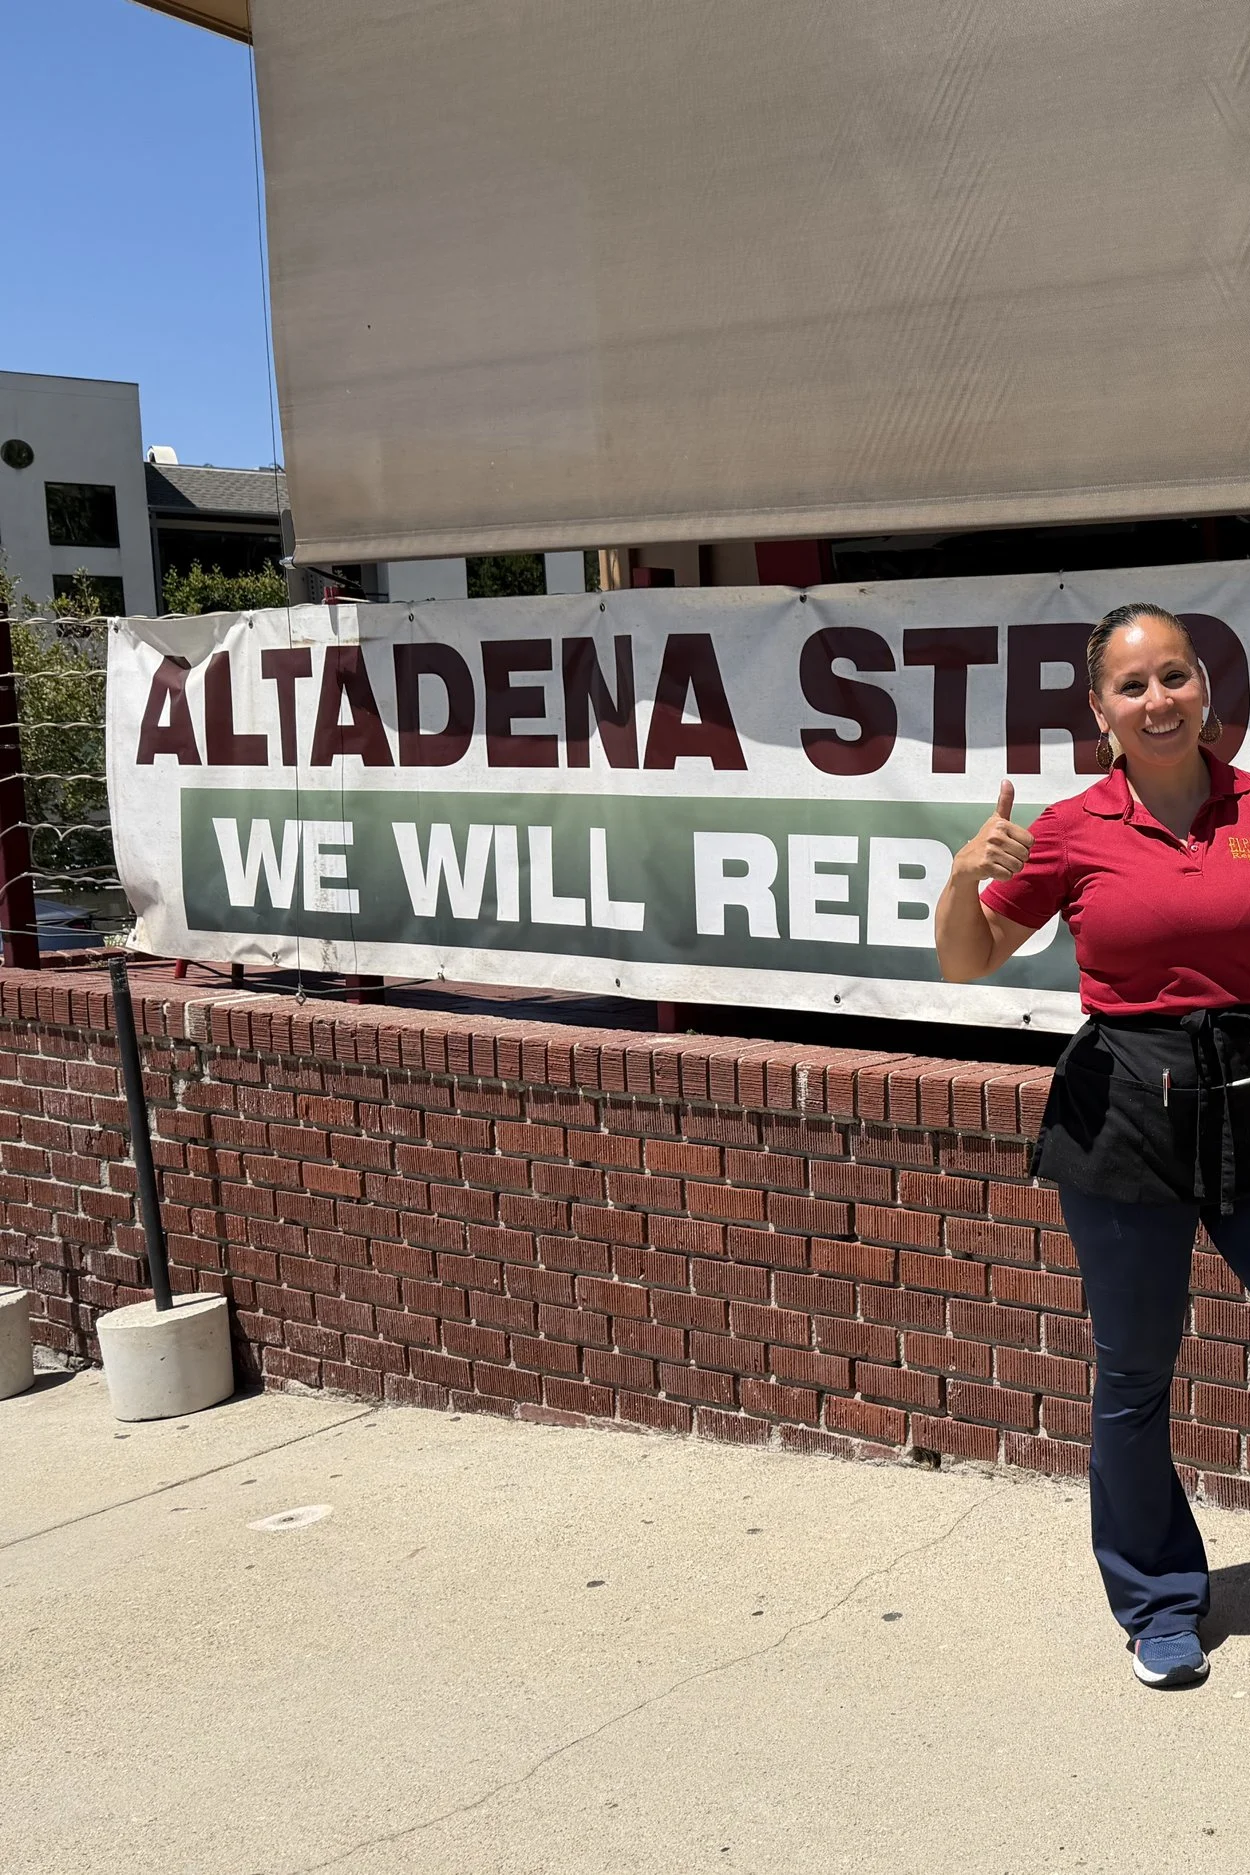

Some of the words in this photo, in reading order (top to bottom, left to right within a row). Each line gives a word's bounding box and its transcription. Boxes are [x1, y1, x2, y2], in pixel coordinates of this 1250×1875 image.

[136, 634, 748, 771] ALTADENA
[212, 817, 359, 914] WE
[392, 822, 645, 932] WILL
